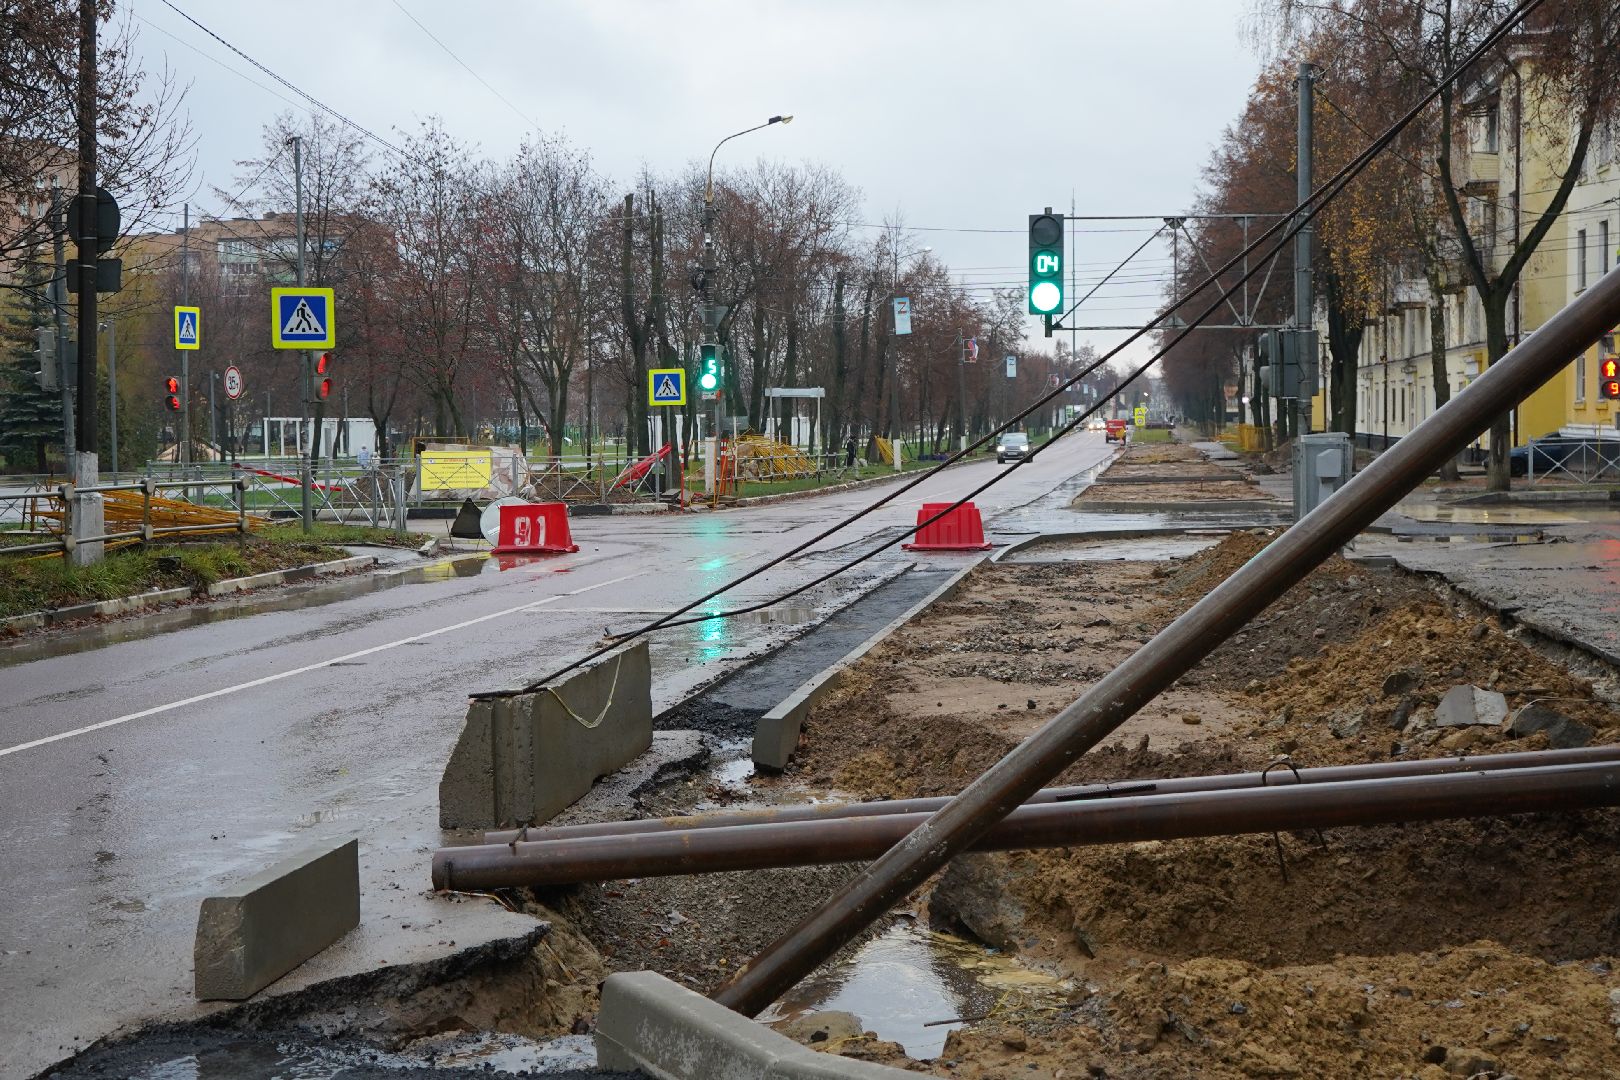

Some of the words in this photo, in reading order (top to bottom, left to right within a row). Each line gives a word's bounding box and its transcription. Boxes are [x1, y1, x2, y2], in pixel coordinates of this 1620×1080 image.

[1037, 255, 1058, 273] 04
[708, 359, 717, 374] 5
[1611, 382, 1619, 394] 9
[514, 515, 546, 547] 91
